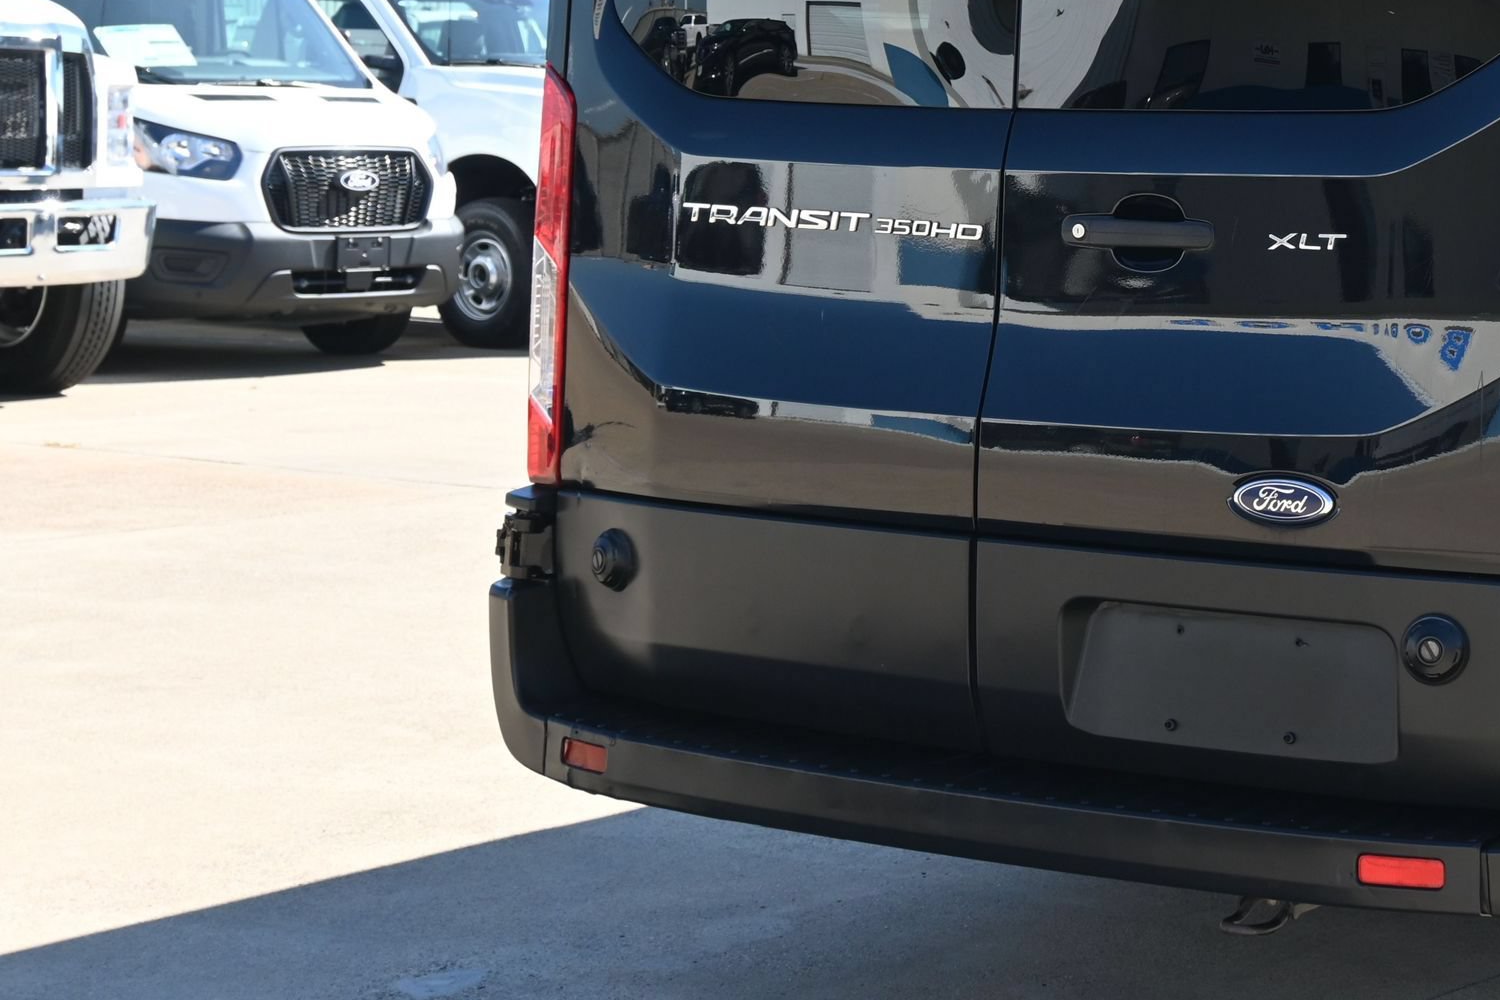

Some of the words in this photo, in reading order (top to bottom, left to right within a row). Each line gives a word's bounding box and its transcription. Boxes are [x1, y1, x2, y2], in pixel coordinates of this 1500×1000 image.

[682, 202, 871, 231] TRANSIT
[874, 217, 983, 240] 350HD
[1267, 232, 1347, 250] XLT
[1253, 486, 1308, 513] Ford
